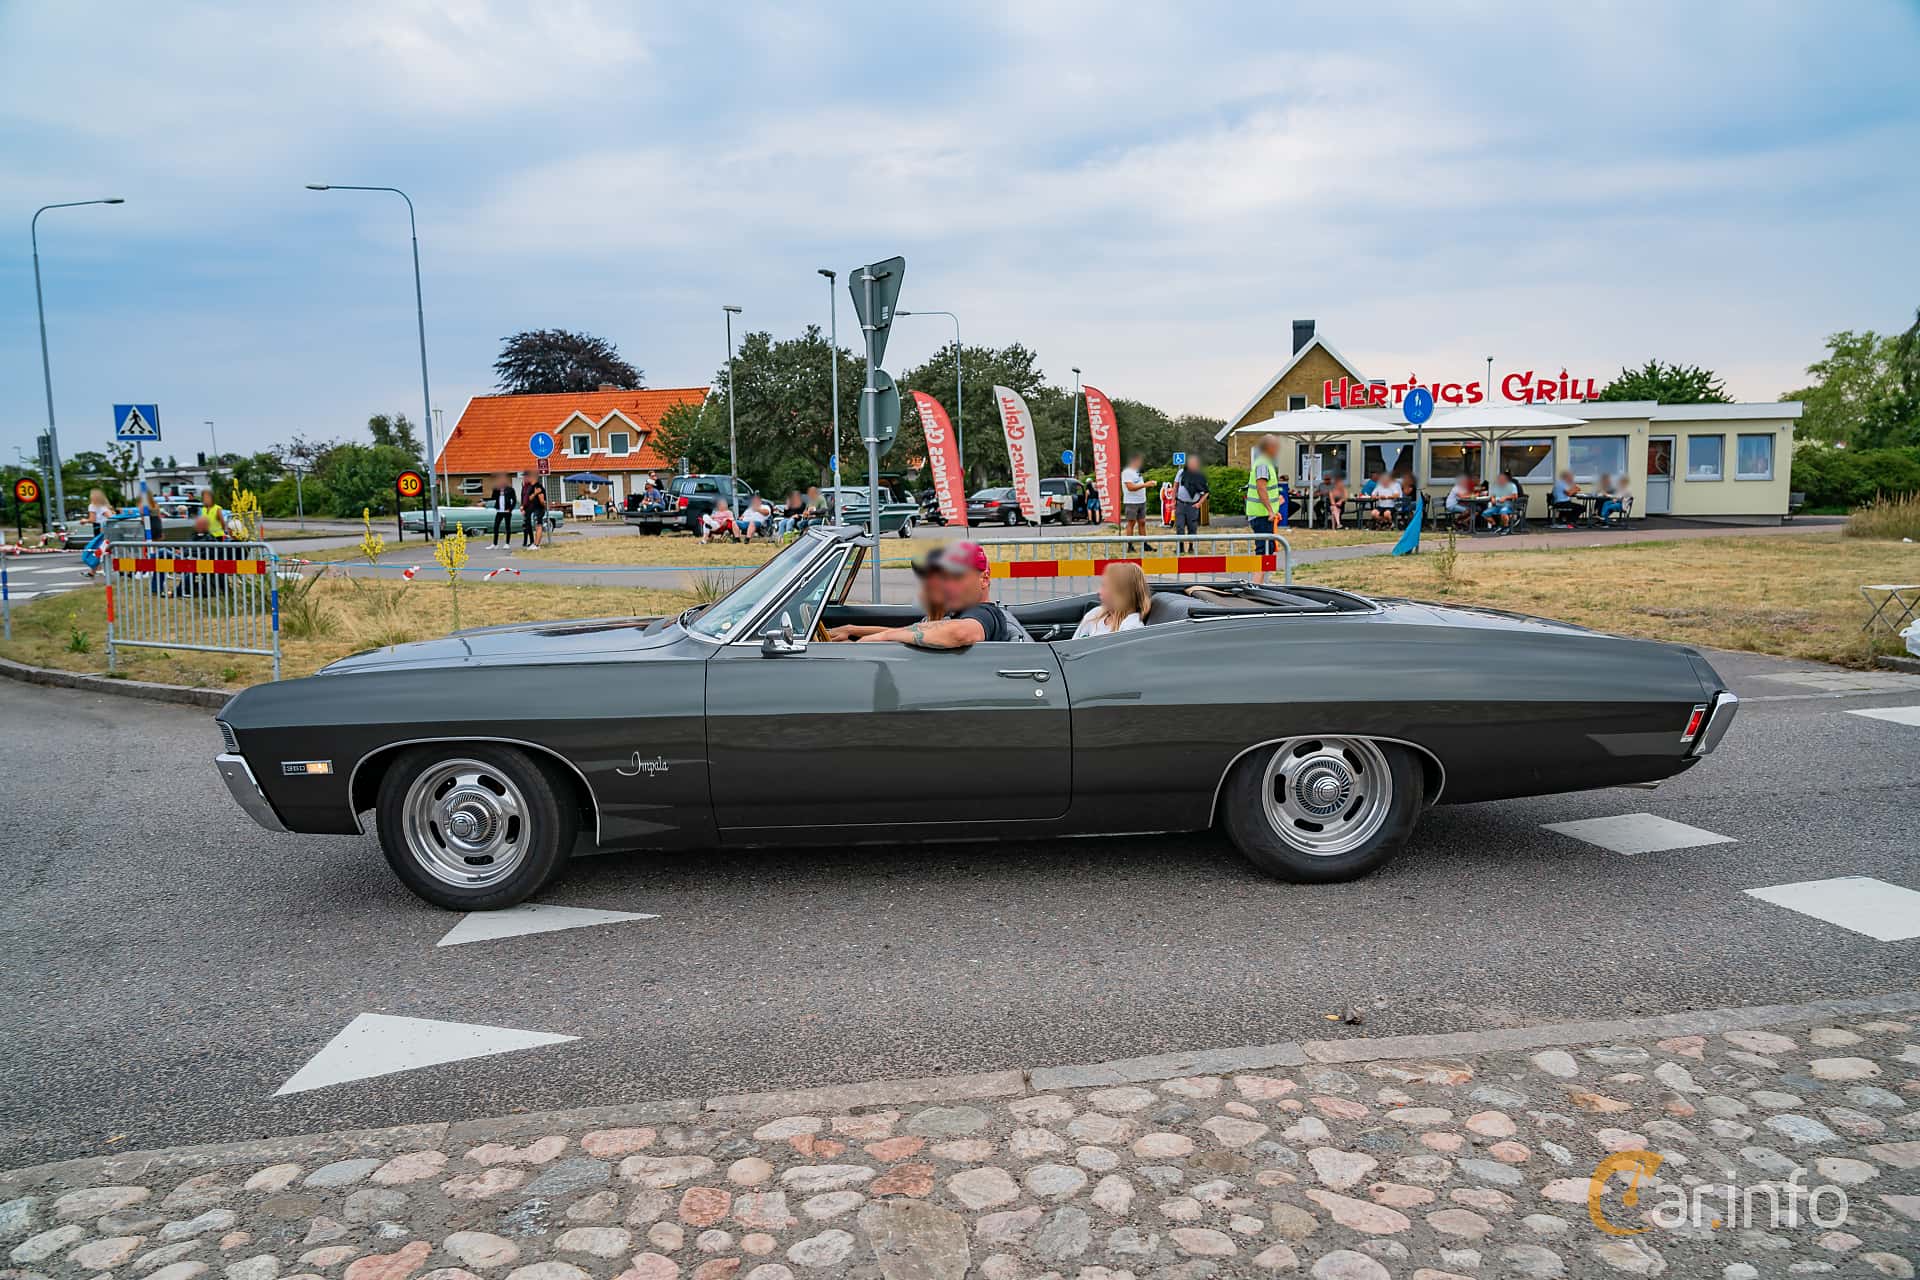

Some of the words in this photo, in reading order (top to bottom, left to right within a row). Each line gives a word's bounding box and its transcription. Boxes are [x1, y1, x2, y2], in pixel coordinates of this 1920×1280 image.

[402, 479, 418, 490] 30
[21, 485, 35, 496] 30
[615, 751, 670, 777] Impala
